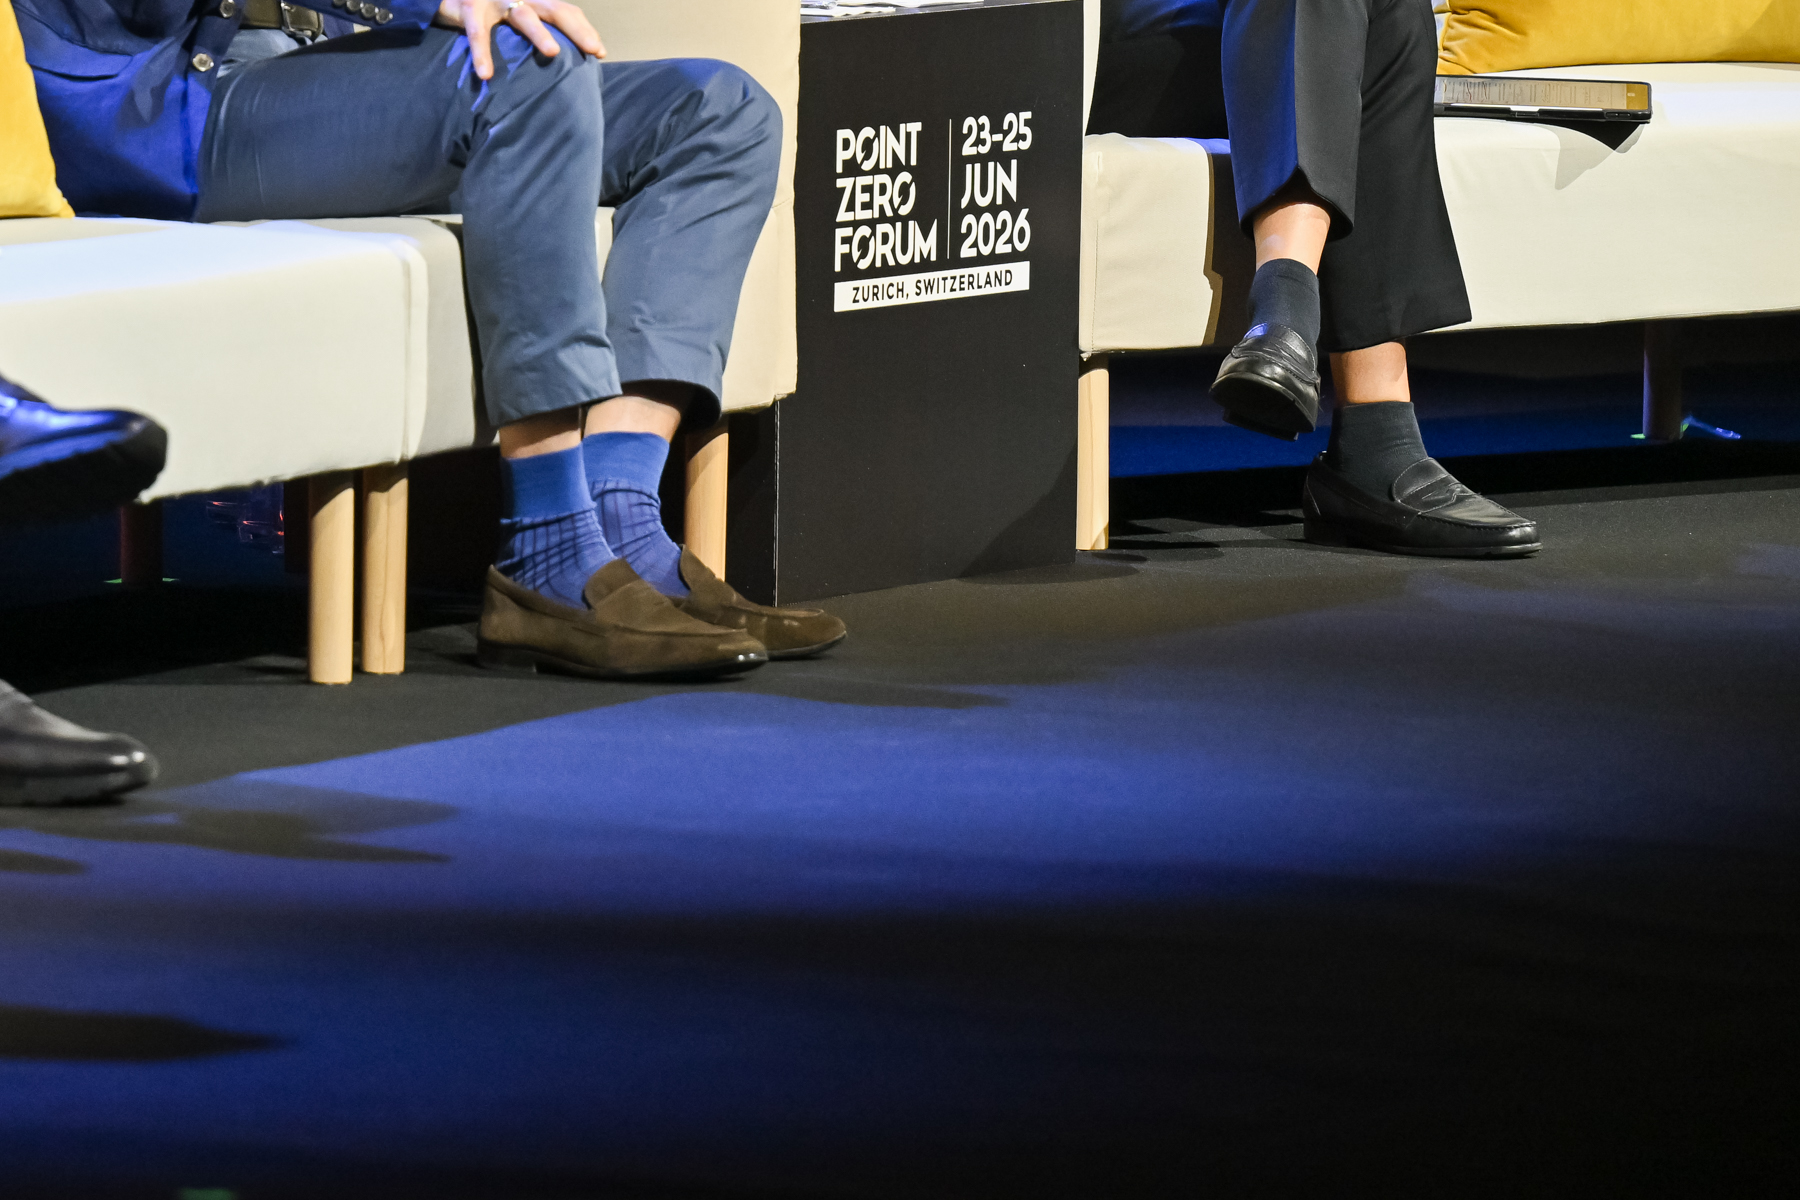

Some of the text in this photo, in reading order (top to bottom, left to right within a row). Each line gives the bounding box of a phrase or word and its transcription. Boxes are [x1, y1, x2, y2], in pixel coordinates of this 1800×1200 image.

[836, 121, 922, 174] POINT
[962, 111, 1032, 156] 23-25
[836, 171, 916, 222] ZERO
[961, 159, 1017, 209] JUN
[835, 218, 938, 272] FORUM
[960, 208, 1031, 258] 2026
[852, 269, 1013, 304] ZURICH, SWITZERLAND
